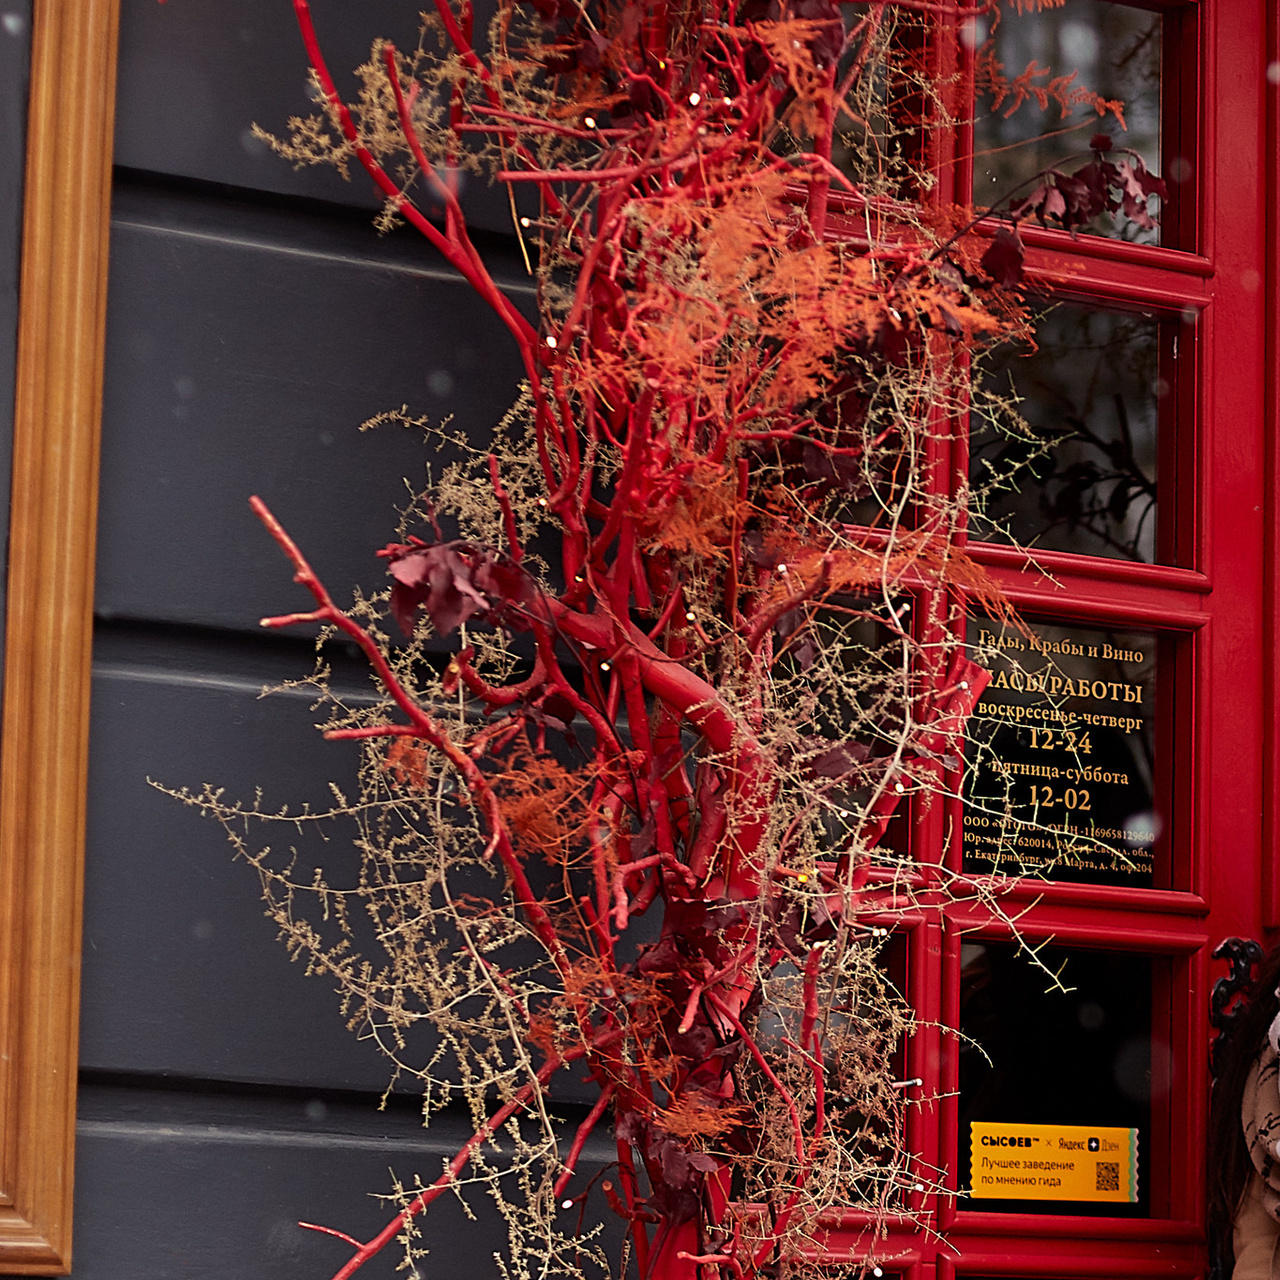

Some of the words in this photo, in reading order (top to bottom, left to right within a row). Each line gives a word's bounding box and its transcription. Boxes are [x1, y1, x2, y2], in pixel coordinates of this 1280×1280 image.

[978, 629, 1025, 651] Гады,
[1029, 634, 1083, 657] Крабы
[1088, 646, 1098, 658] и
[1102, 643, 1144, 663] Вино
[1050, 675, 1143, 704] РАБОТЫ
[978, 702, 1143, 731] воскресенье-четверг
[1029, 728, 1092, 754] 12-24
[991, 760, 1129, 785] пятница-суббота
[1029, 785, 1092, 810] 12-02
[963, 816, 989, 828] ООО
[964, 832, 984, 845] Юр.
[1058, 1138, 1085, 1151] Яндекс
[1101, 1139, 1120, 1152] Дзен
[981, 1157, 1020, 1170] Лучшее
[1022, 1159, 1075, 1171] заведение
[981, 1175, 994, 1184] по
[996, 1176, 1036, 1186] мнению
[1038, 1178, 1062, 1187] гида
